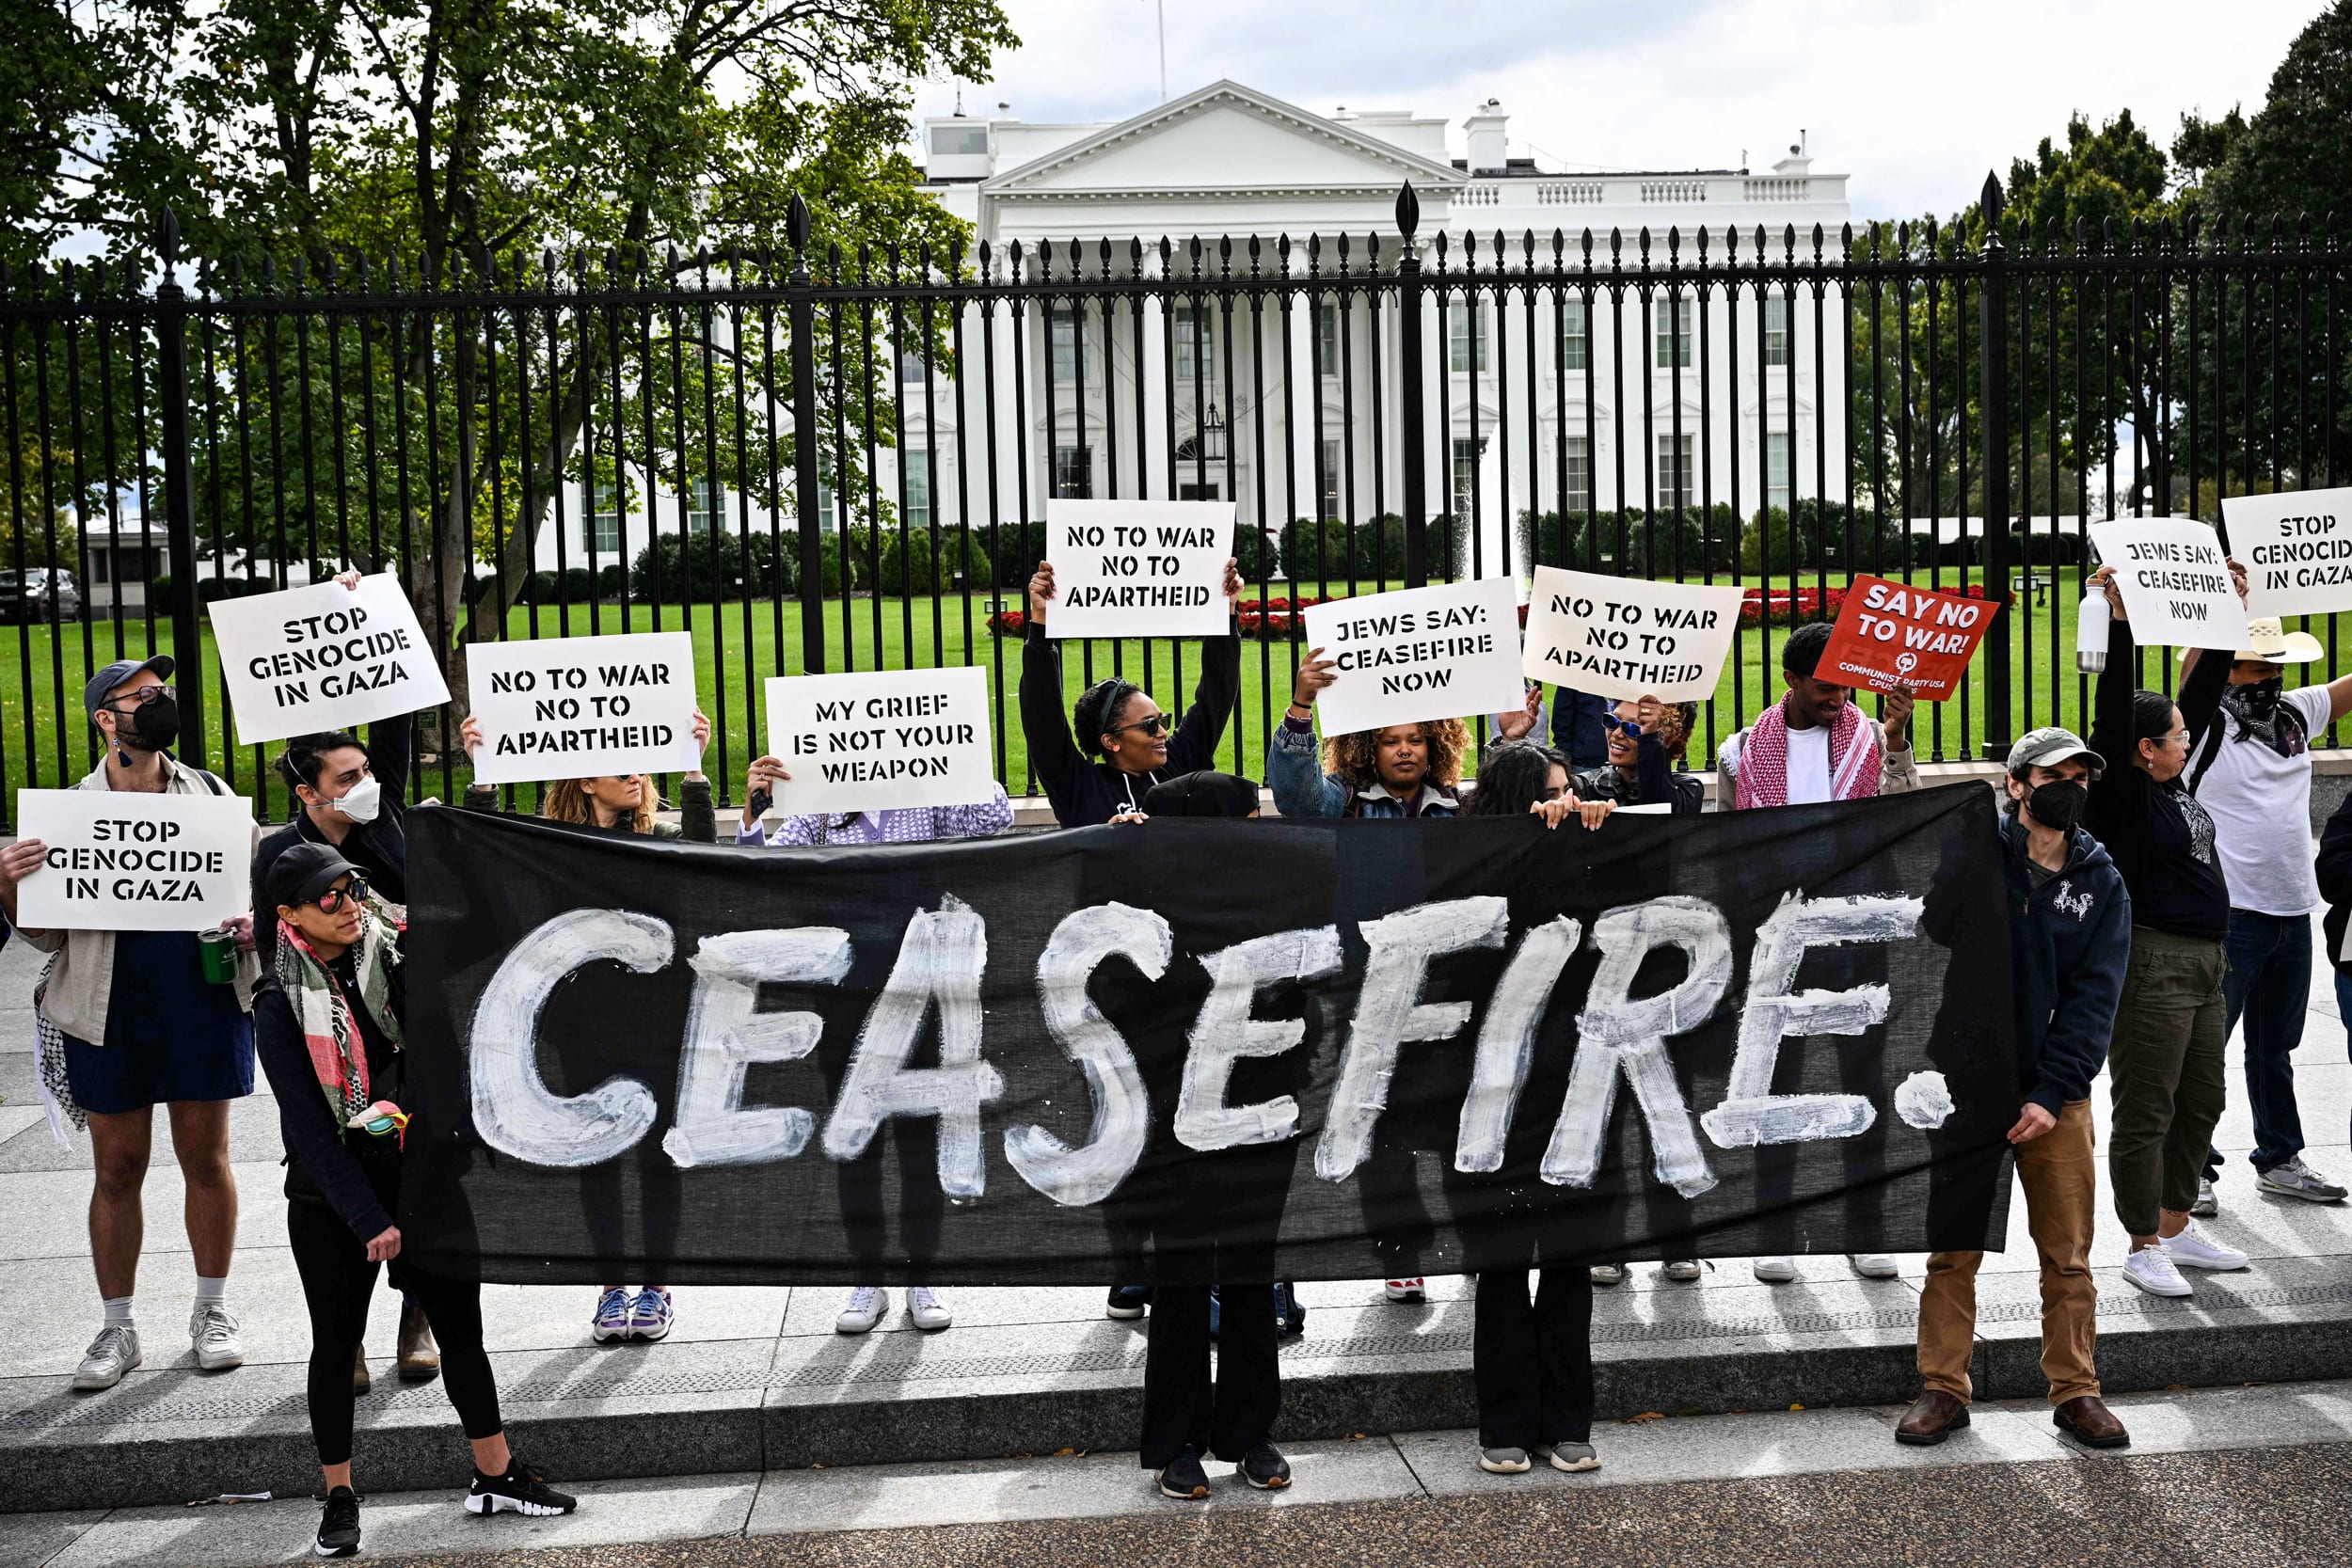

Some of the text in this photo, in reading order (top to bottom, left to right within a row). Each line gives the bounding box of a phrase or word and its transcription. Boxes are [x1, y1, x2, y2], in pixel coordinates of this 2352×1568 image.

[1067, 526, 1216, 548] NO TO WAR
[2280, 515, 2336, 537] STOP
[1102, 555, 1180, 577] NO TO
[2125, 542, 2219, 565] JEWS SAY:
[2137, 570, 2227, 594] CEASEFIRE
[2266, 564, 2352, 591] IN GAZA
[1065, 585, 1210, 608] APARTHEID
[1863, 584, 1980, 629] SAY NO
[282, 606, 369, 644] STOP
[1336, 604, 1487, 642] JEWS SAY:
[1550, 594, 1718, 629] NO TO WAR
[2169, 600, 2207, 622] NOW
[1585, 626, 1676, 656] NO TO
[1857, 613, 1971, 655] TO WAR!
[248, 627, 412, 680] GENOCIDE
[1336, 633, 1494, 672] CEASEFIRE
[1544, 645, 1704, 685] APARTHEID
[274, 659, 410, 707] IN GAZA
[491, 663, 671, 694] NO TO WAR
[1381, 668, 1453, 695] NOW
[1838, 661, 1945, 689] COMMUNIST PARTY USA
[535, 695, 630, 721] NO TO
[816, 694, 948, 722] MY GRIEF
[496, 724, 673, 756] APARTHEID
[793, 723, 974, 755] IS NOT YOUR
[820, 755, 948, 784] WEAPON
[92, 818, 181, 843] STOP
[45, 847, 223, 875] GENOCIDE
[66, 877, 204, 902] IN GAZA
[469, 892, 1957, 1207] CEASEFIRE.
